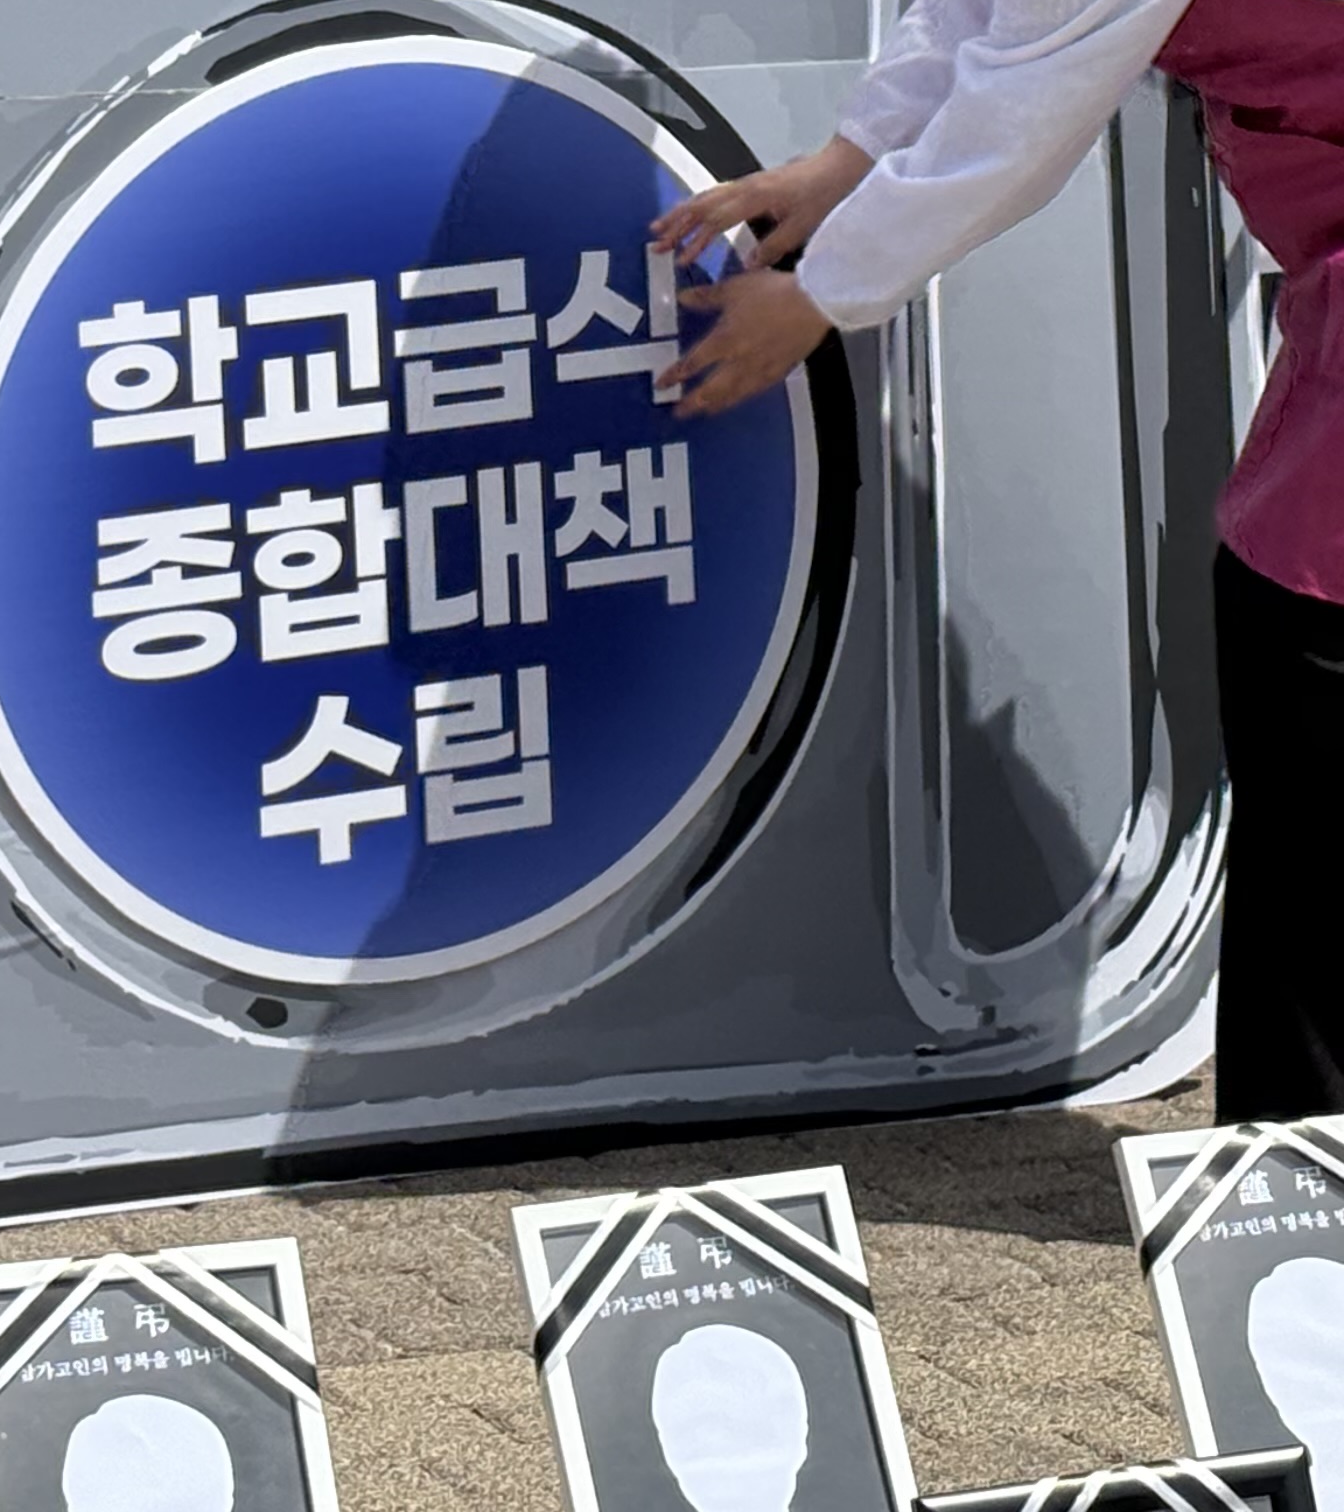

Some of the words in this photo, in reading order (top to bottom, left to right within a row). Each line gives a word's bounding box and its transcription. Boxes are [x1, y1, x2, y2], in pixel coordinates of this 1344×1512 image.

[79, 242, 682, 464] 학교급식
[92, 442, 696, 681] 종합대책
[260, 665, 553, 865] 수립
